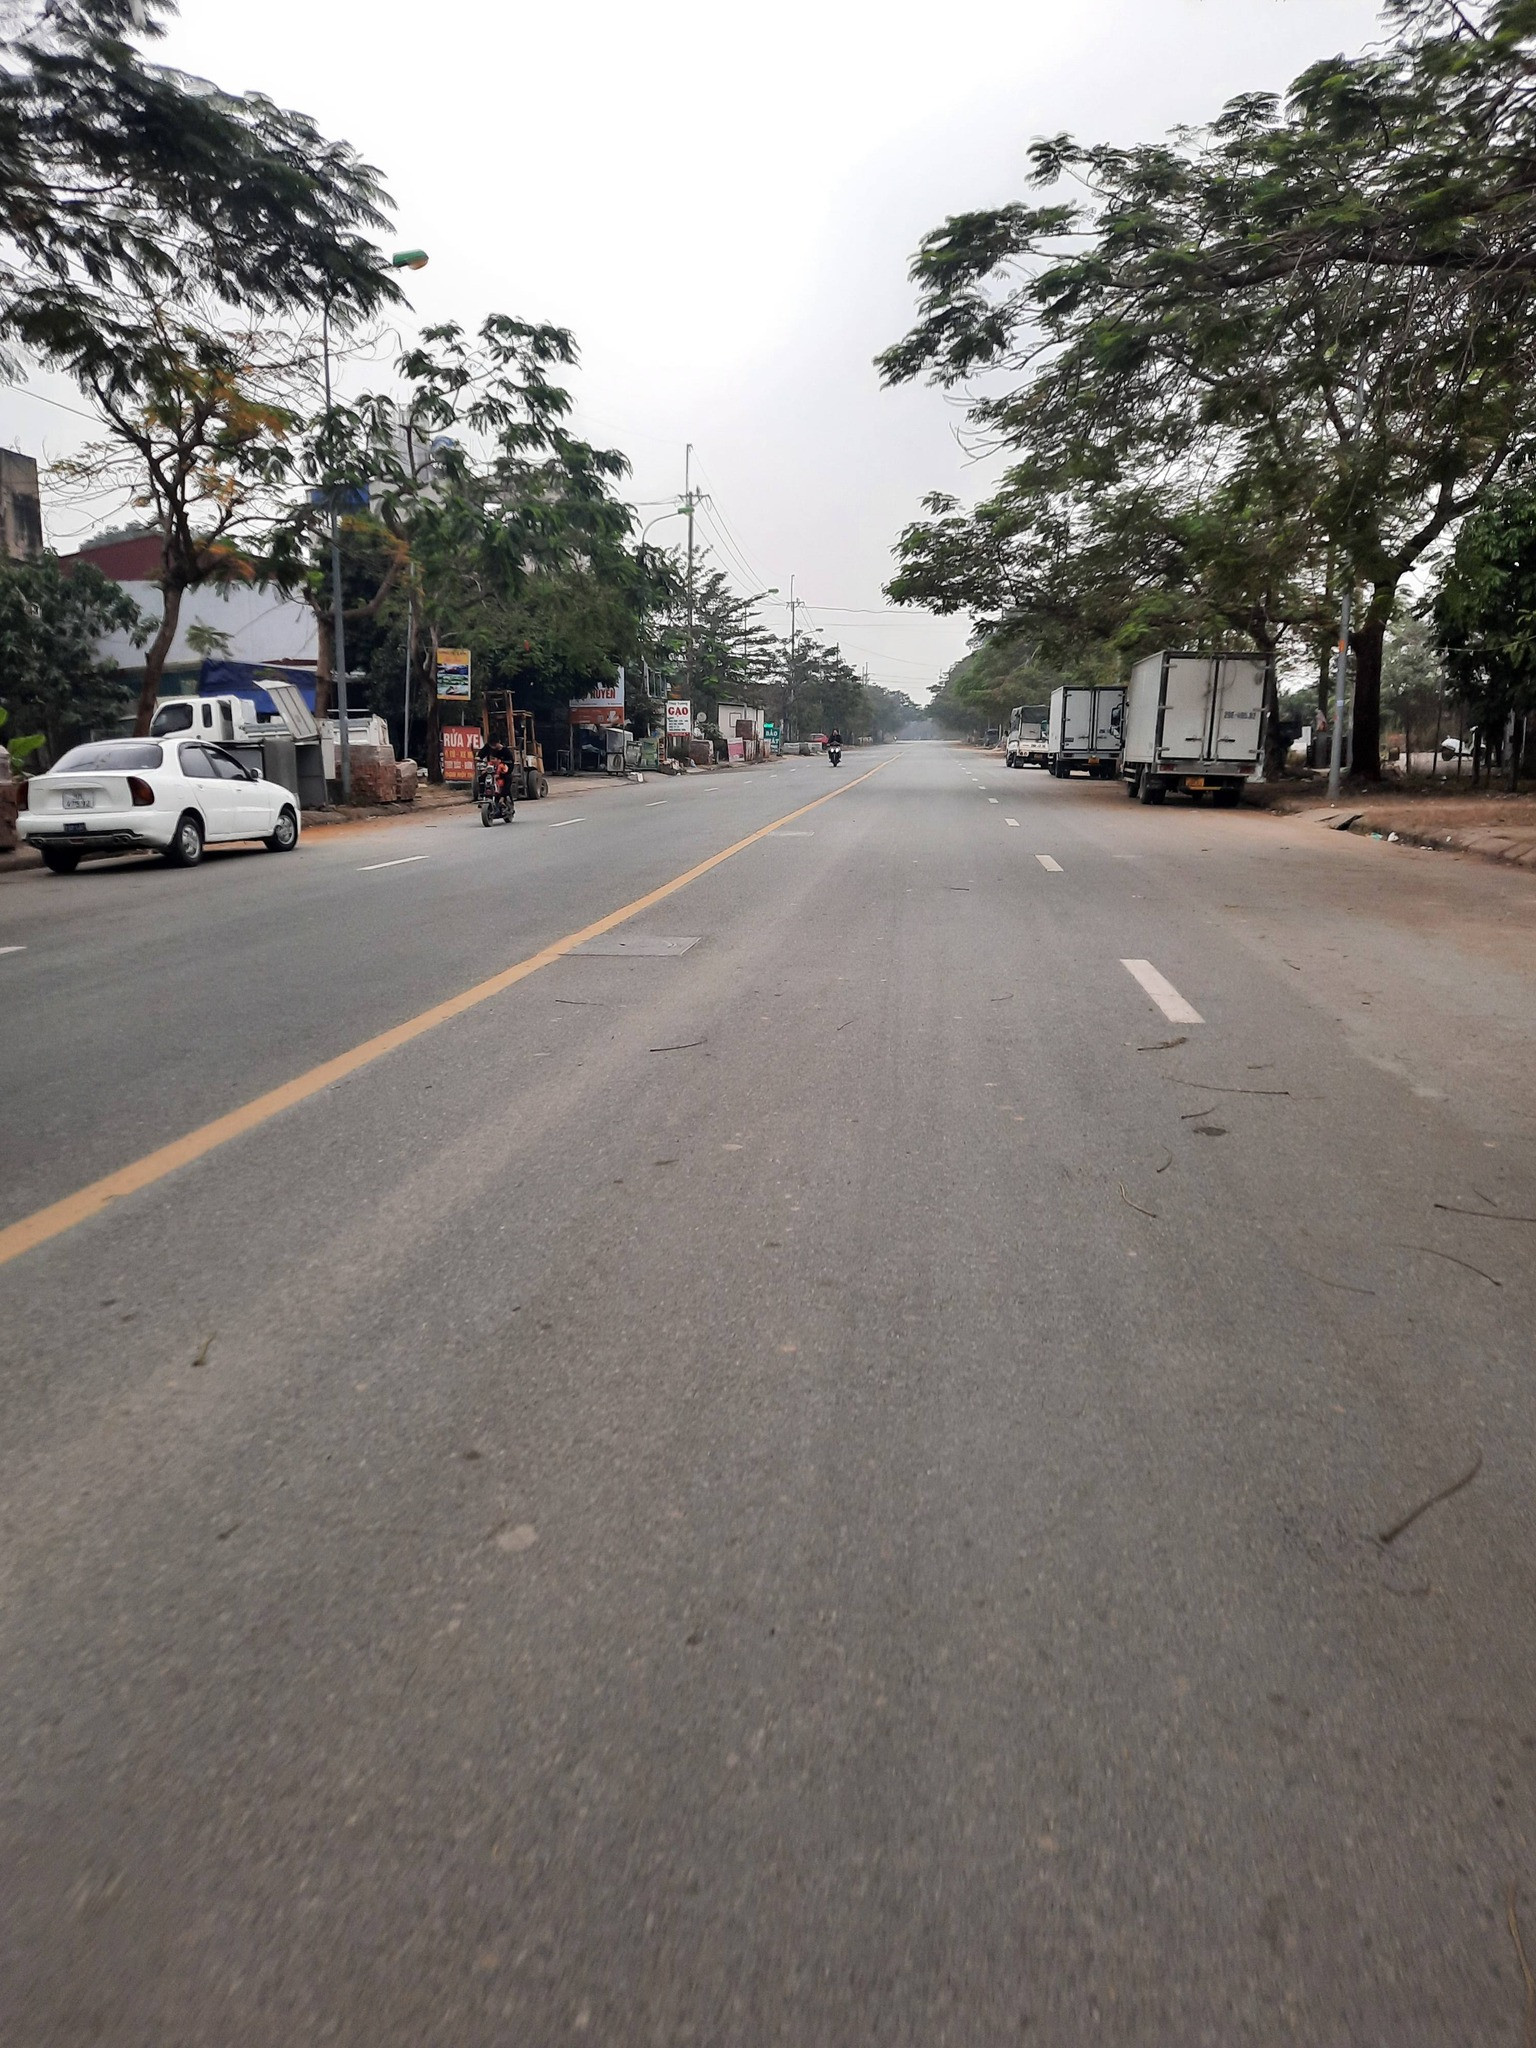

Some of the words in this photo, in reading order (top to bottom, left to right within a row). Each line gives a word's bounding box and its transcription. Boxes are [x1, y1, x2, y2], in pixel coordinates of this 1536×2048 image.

[668, 706, 689, 717] GẠO
[443, 728, 464, 747] RỬA
[466, 733, 479, 748] XE
